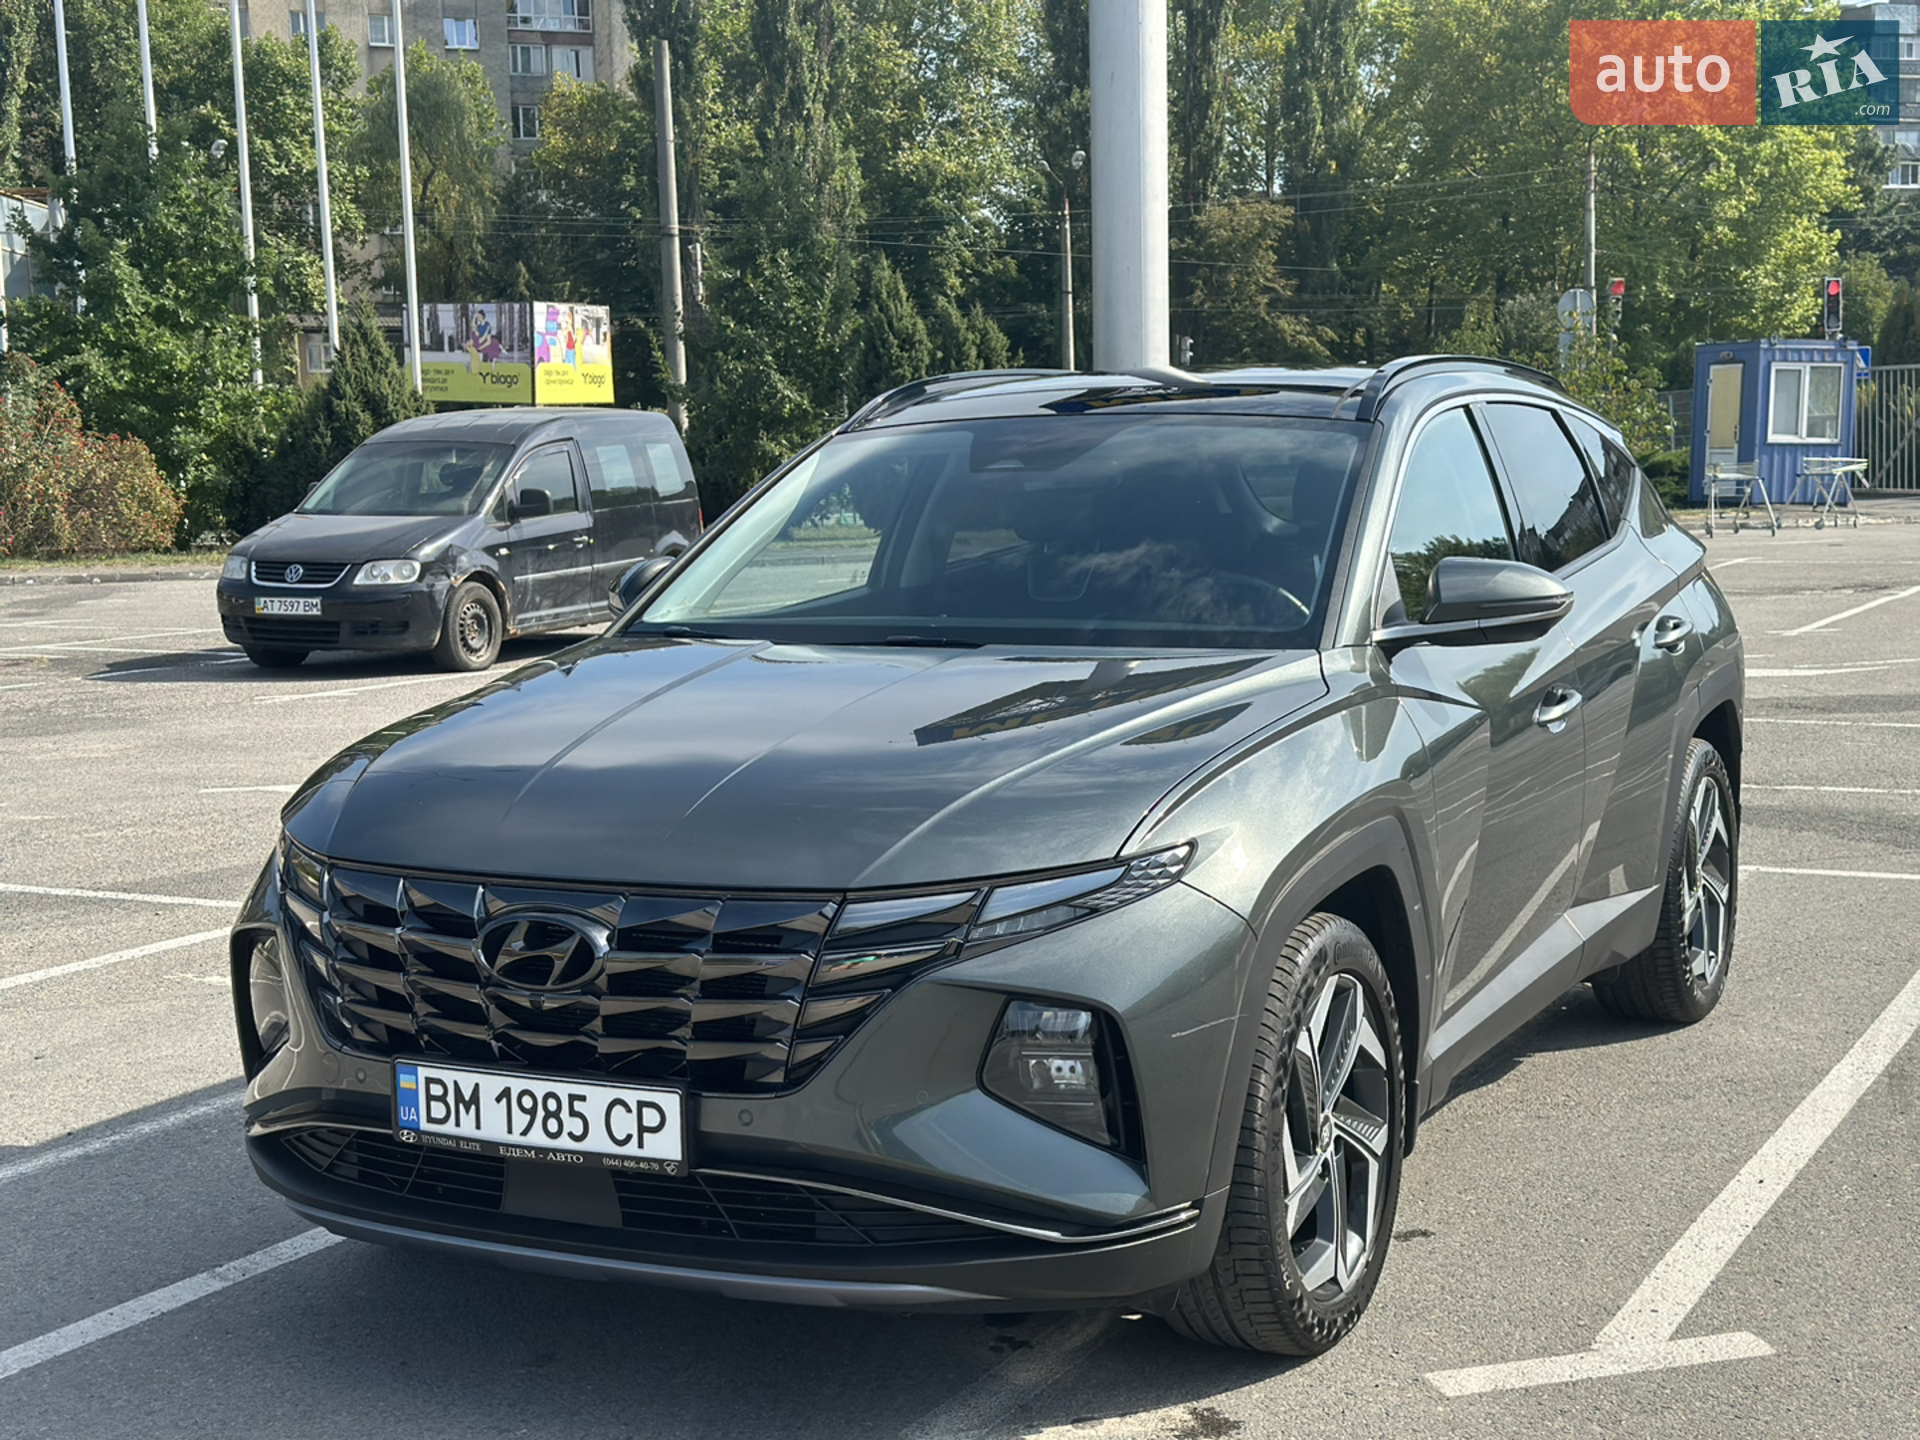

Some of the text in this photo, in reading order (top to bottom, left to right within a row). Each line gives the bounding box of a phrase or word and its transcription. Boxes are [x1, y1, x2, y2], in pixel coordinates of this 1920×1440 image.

[262, 600, 320, 612] AT 7597 BM
[400, 1106, 418, 1122] UA
[424, 1076, 667, 1149] BM 1985 CP
